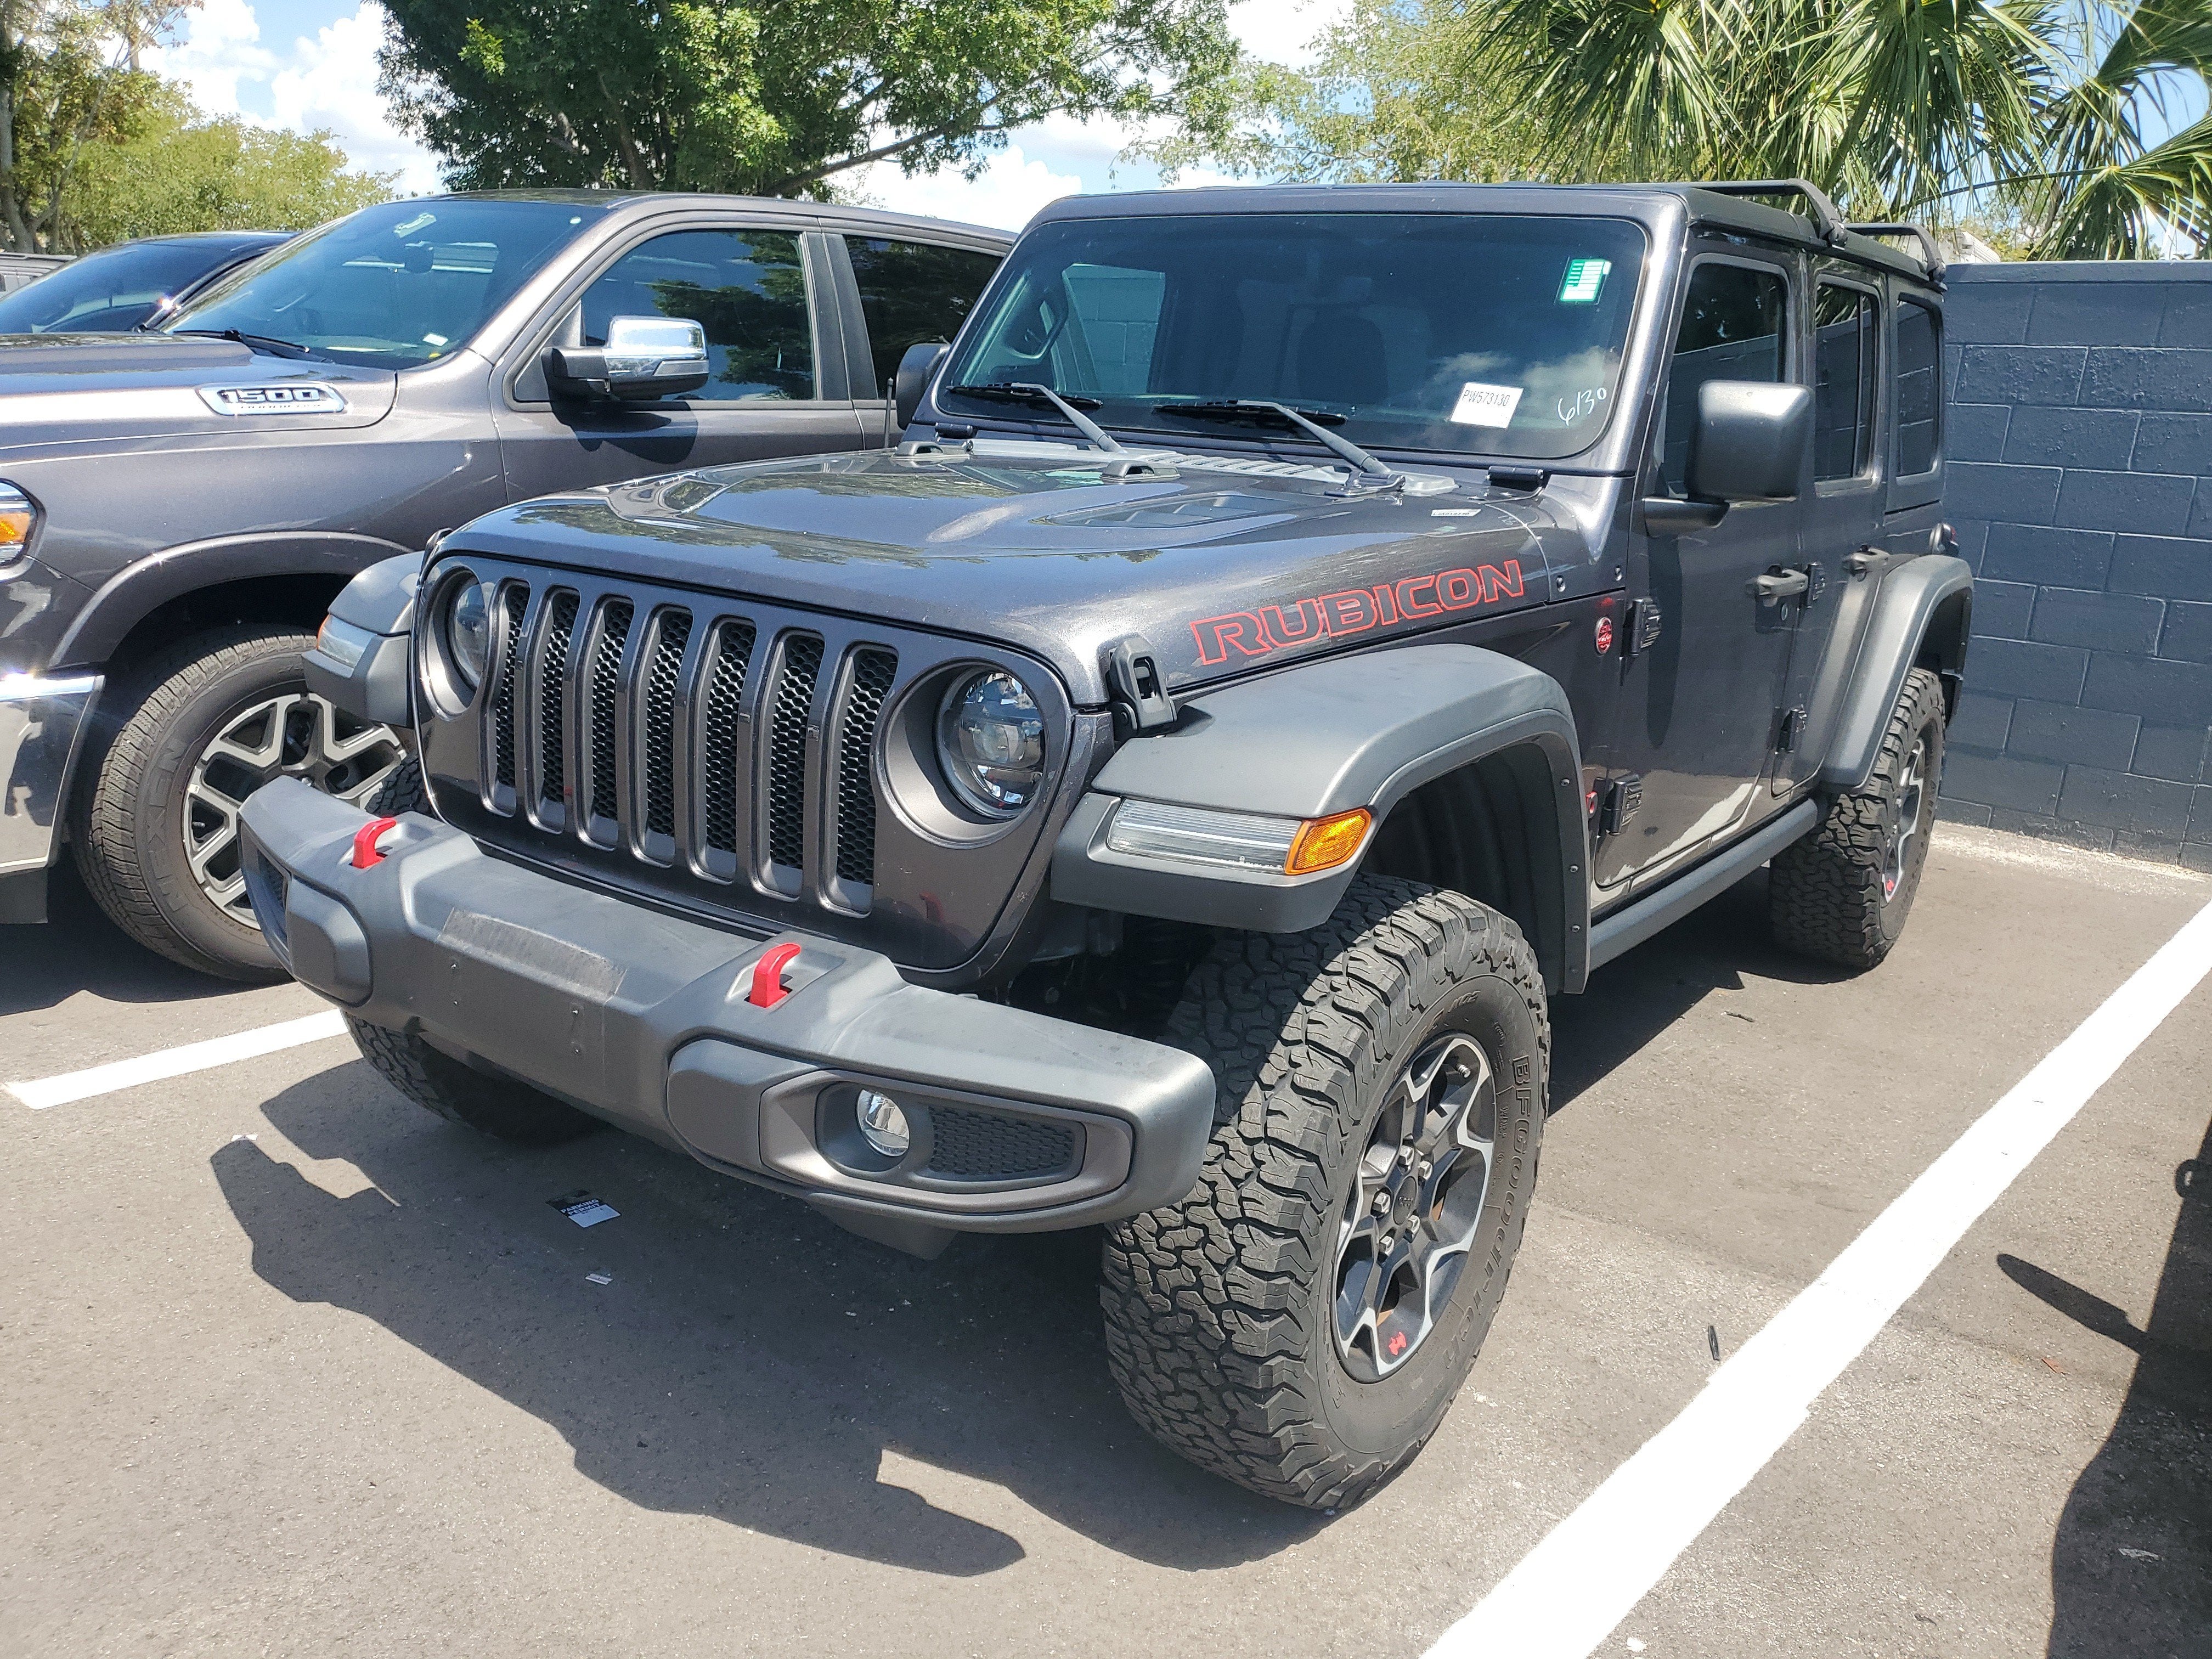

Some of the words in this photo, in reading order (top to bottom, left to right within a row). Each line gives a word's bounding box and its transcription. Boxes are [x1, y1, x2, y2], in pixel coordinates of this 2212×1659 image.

[222, 388, 320, 403] 1500
[1462, 389, 1510, 407] PW573130
[1190, 560, 1524, 665] RUBICON
[146, 738, 189, 912] NEXEN
[560, 1199, 599, 1213] PARKING
